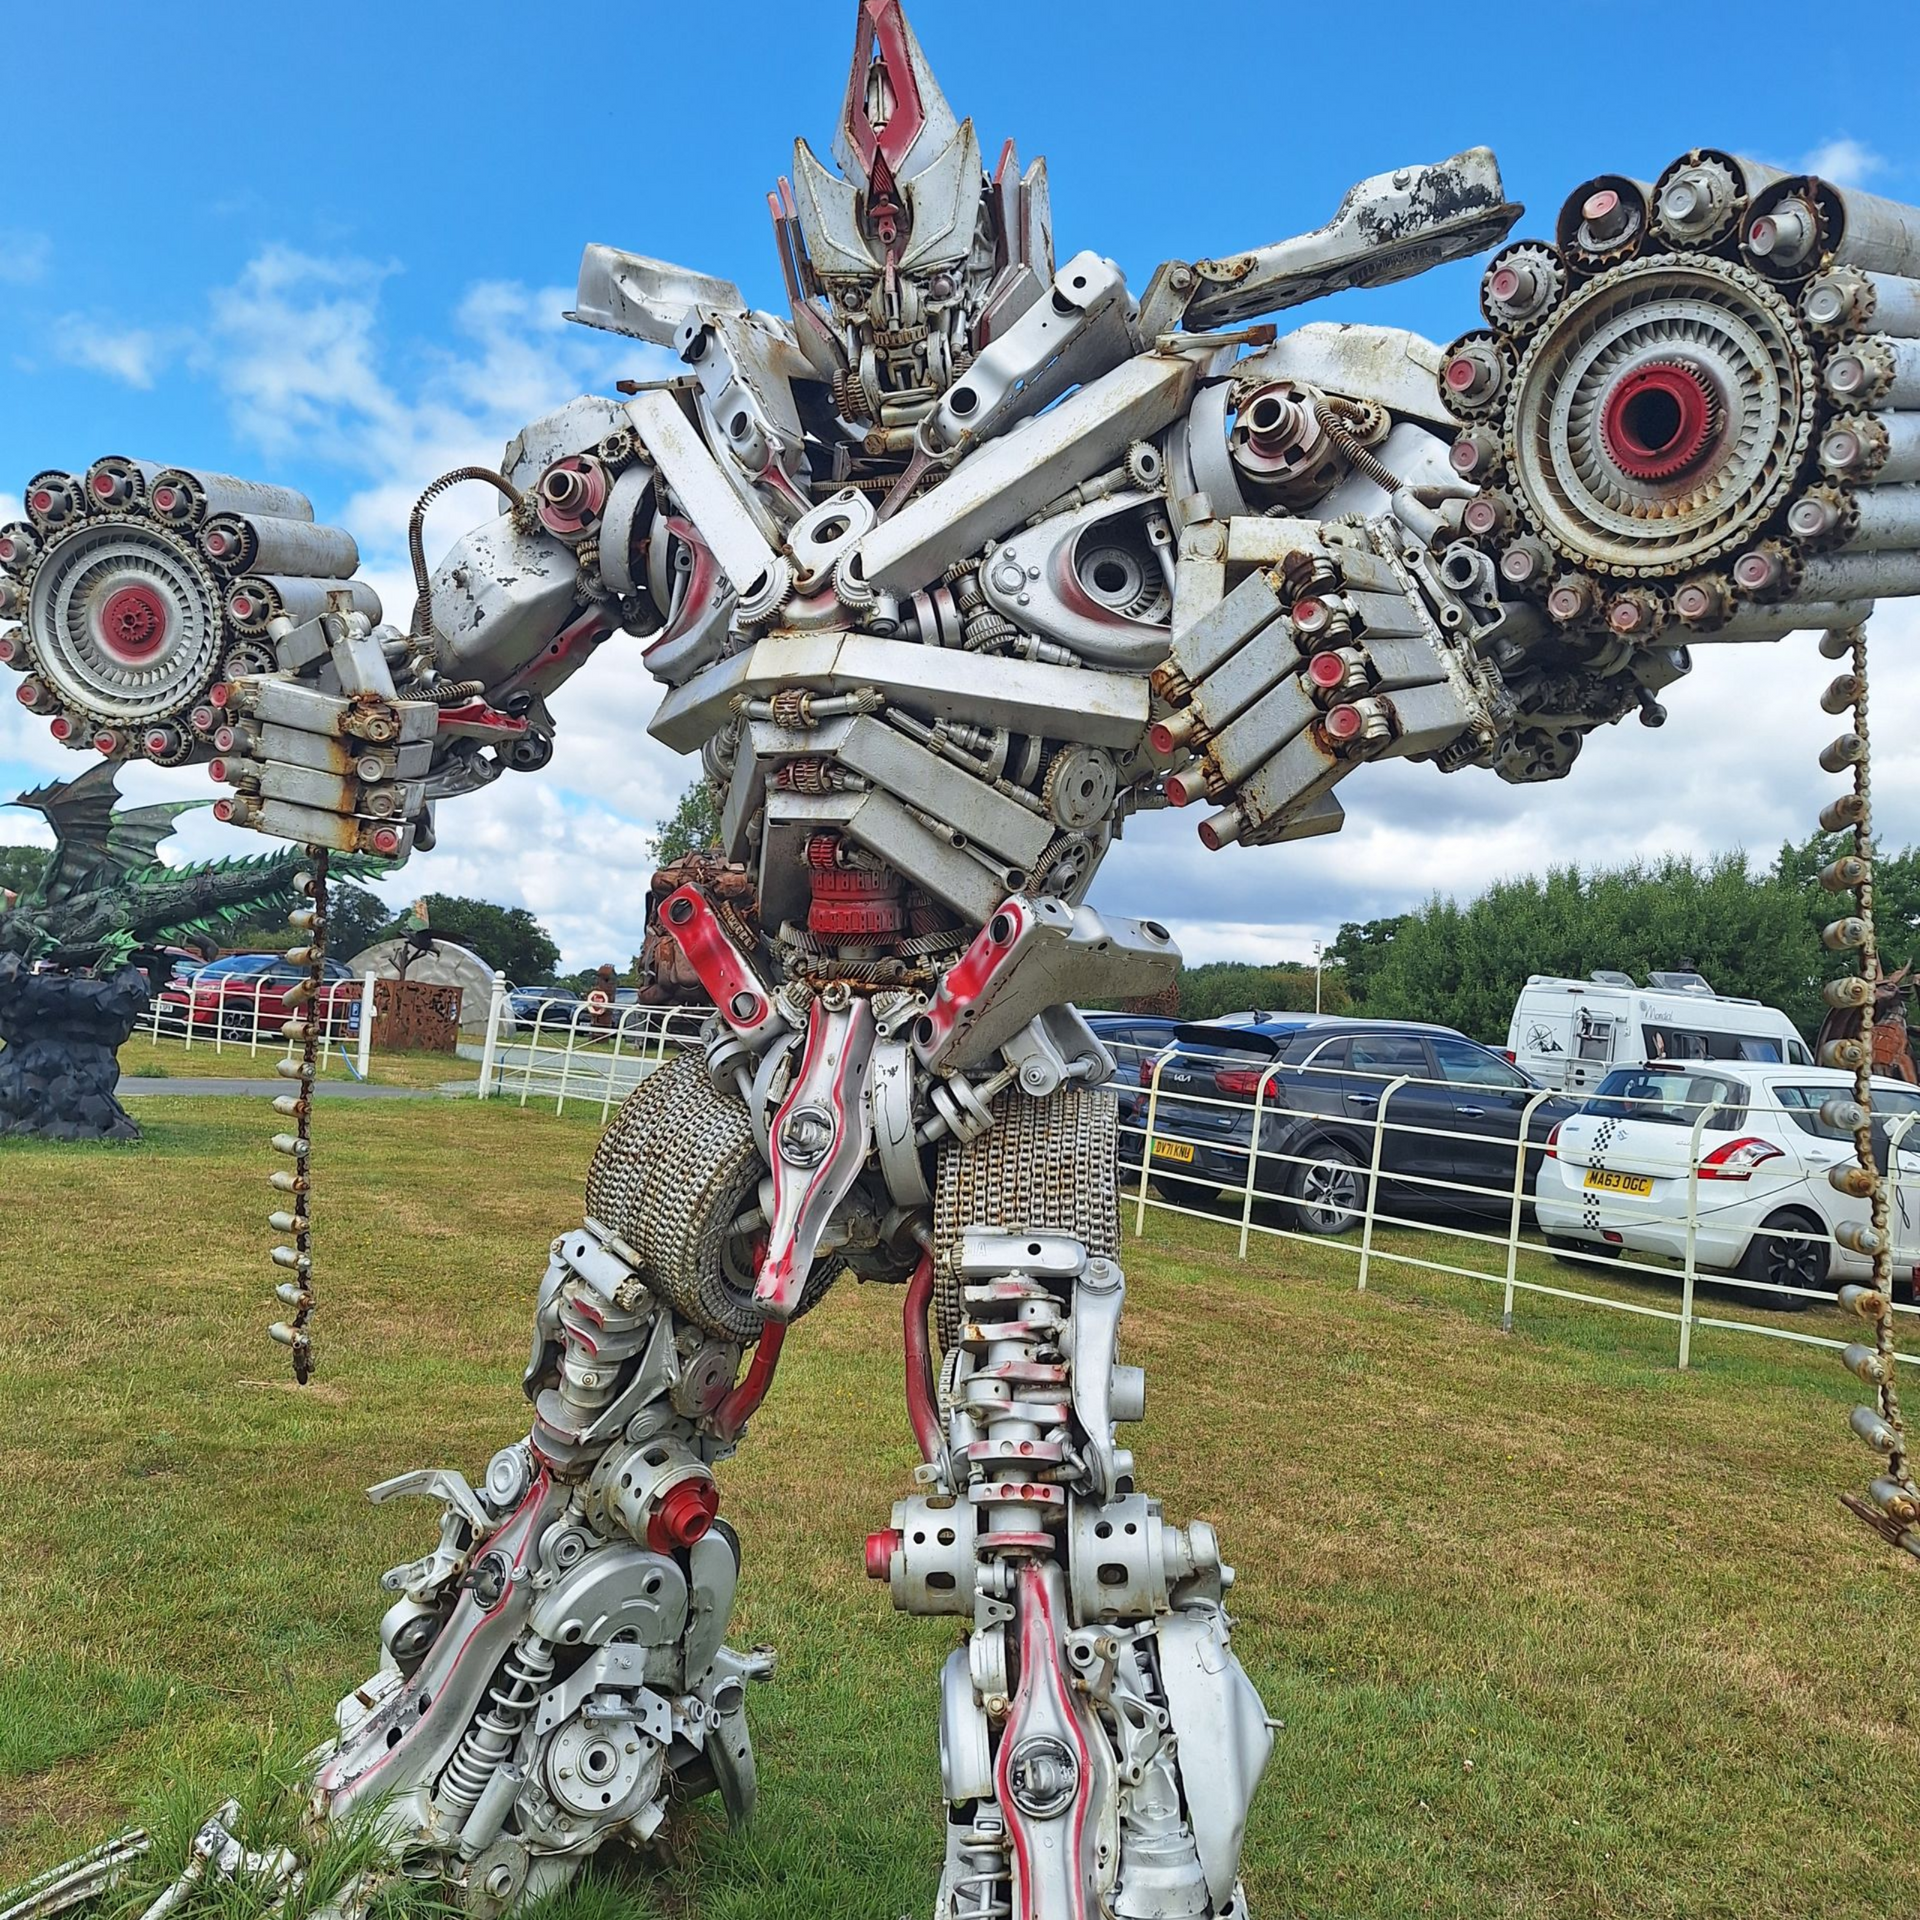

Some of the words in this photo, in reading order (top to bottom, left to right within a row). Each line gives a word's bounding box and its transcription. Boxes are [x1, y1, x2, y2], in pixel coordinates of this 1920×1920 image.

[1174, 1073, 1191, 1082] KIA
[1156, 1141, 1174, 1156] DV71
[1174, 1144, 1191, 1159] KNU
[1589, 1171, 1621, 1188] MA63
[1622, 1176, 1648, 1192] OGC
